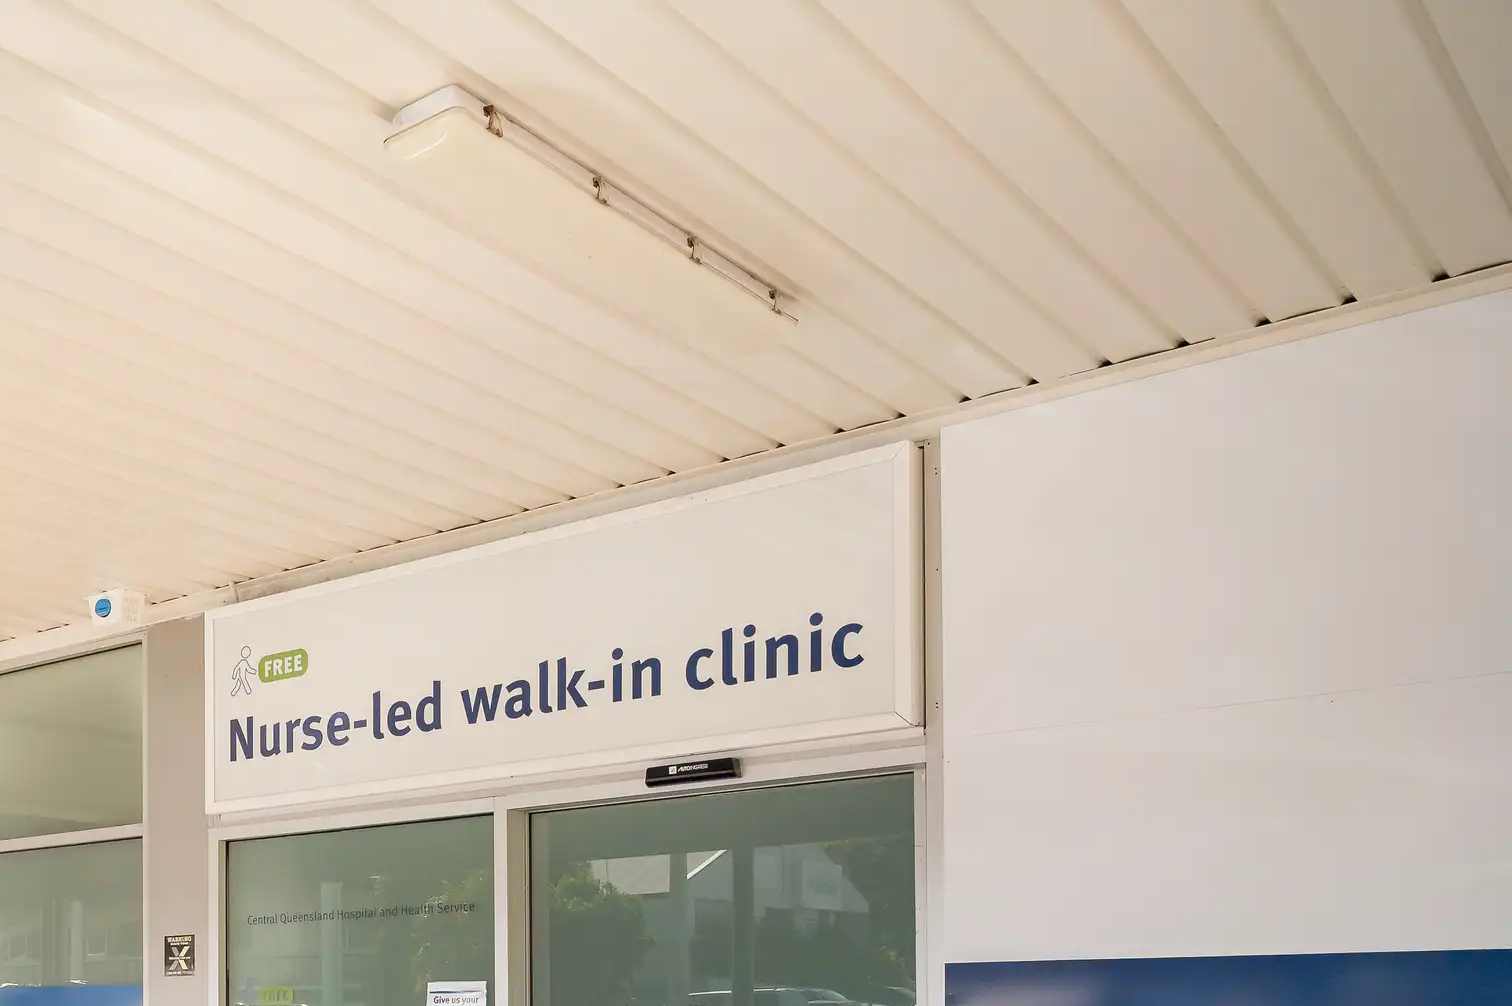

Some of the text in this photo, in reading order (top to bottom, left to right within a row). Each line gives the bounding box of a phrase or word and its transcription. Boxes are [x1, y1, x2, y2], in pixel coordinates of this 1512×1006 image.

[264, 654, 303, 678] FREE
[229, 611, 865, 762] Nurse-led walk-in clinic
[247, 900, 475, 926] Central Queensland Hospital and Health Service
[433, 996, 450, 1004] Give
[462, 997, 479, 1005] your
